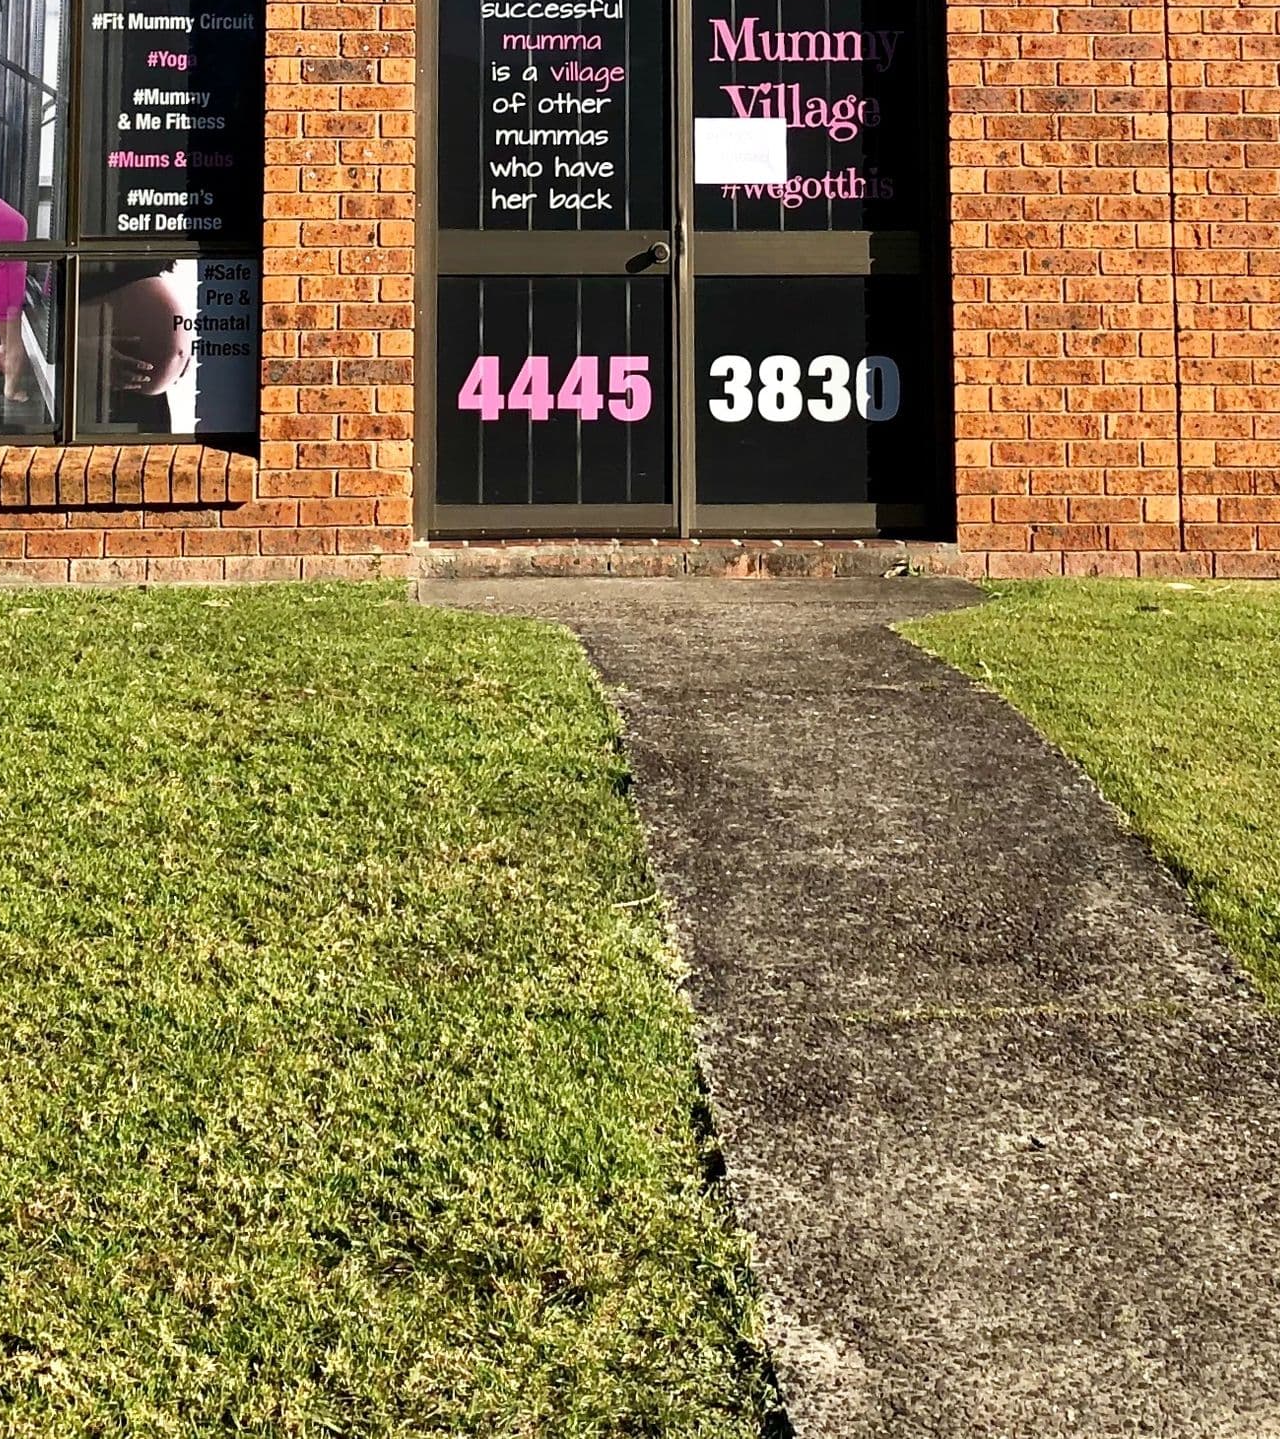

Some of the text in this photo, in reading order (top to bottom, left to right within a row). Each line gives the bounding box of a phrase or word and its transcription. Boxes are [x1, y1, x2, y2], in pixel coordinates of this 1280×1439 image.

[91, 12, 255, 33] #Fit Mummy Circuit
[502, 33, 602, 50] mumma
[708, 17, 904, 73] Mummy
[491, 61, 625, 92] is a village
[132, 87, 211, 108] #Mummy
[492, 91, 612, 114] of other
[117, 112, 226, 130] & Me Fitness
[720, 82, 881, 142] Village
[495, 128, 609, 146] mummas
[107, 150, 170, 168] #Mums
[174, 150, 188, 168] &
[489, 155, 615, 178] who have
[126, 188, 214, 206] #Women's
[491, 187, 613, 210] her back
[117, 213, 223, 231] Self Defense
[204, 263, 252, 281] #Safe
[206, 289, 251, 305] Pre &
[173, 314, 251, 331] Postnatal
[191, 339, 251, 356] Fitness
[457, 354, 901, 423] 4445 3830
